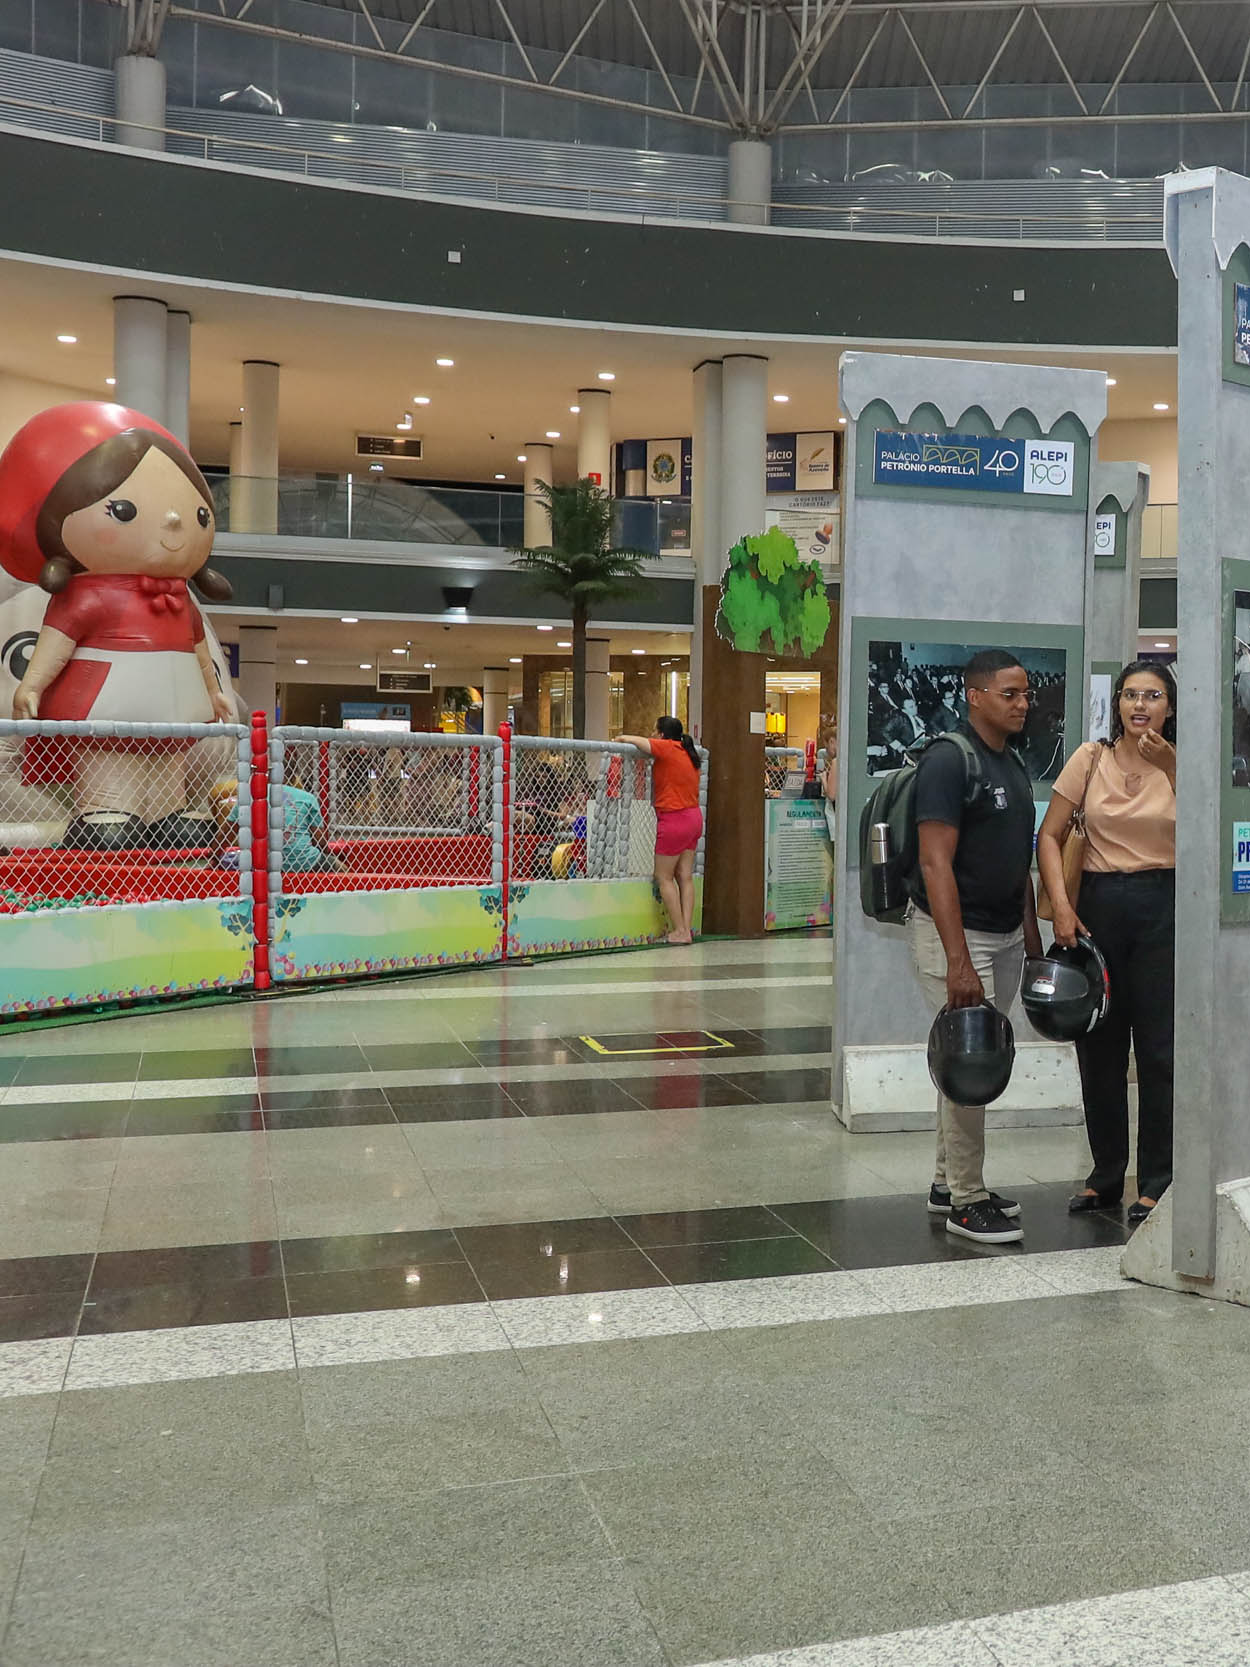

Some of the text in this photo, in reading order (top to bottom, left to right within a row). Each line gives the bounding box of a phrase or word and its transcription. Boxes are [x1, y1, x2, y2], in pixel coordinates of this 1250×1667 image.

[767, 449, 793, 460] FÍCIO
[881, 448, 920, 462] PALÁCIO
[1029, 449, 1068, 463] ALEPI
[881, 460, 975, 475] PETRÔNIO PORTELLA
[983, 449, 1019, 478] 40
[1030, 463, 1067, 486] 190
[1096, 521, 1112, 531] EPI
